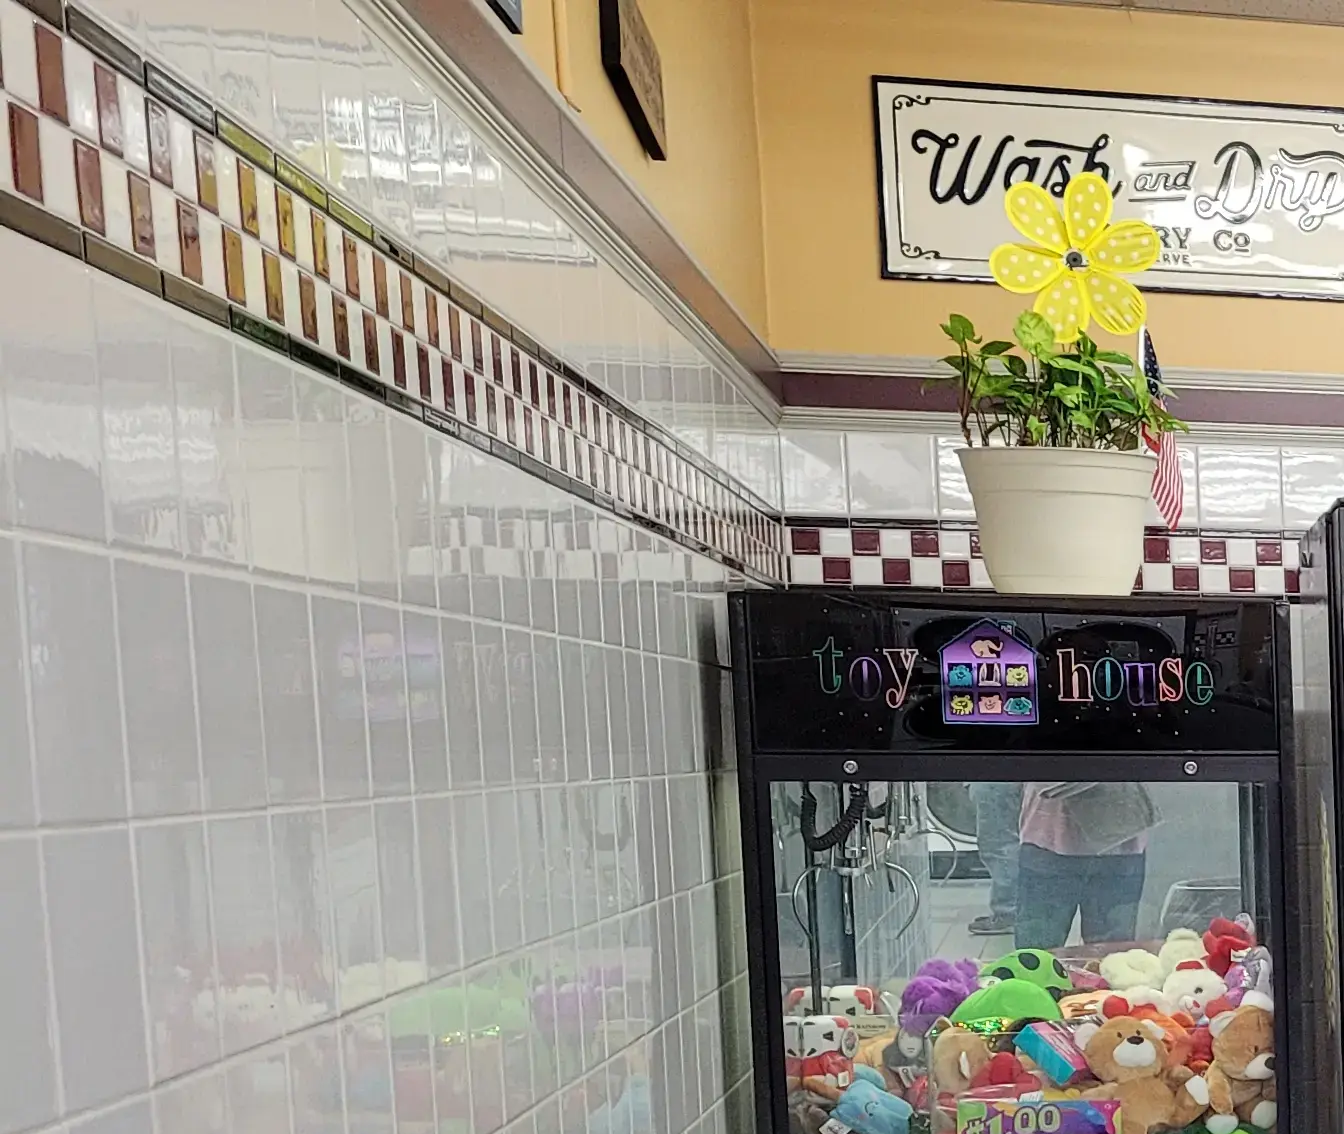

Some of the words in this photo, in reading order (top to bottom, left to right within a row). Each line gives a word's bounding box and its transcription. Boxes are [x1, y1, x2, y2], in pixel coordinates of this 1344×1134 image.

[1134, 159, 1193, 193] and
[1213, 229, 1250, 252] Co
[812, 636, 919, 709] toy
[1057, 647, 1214, 707] house
